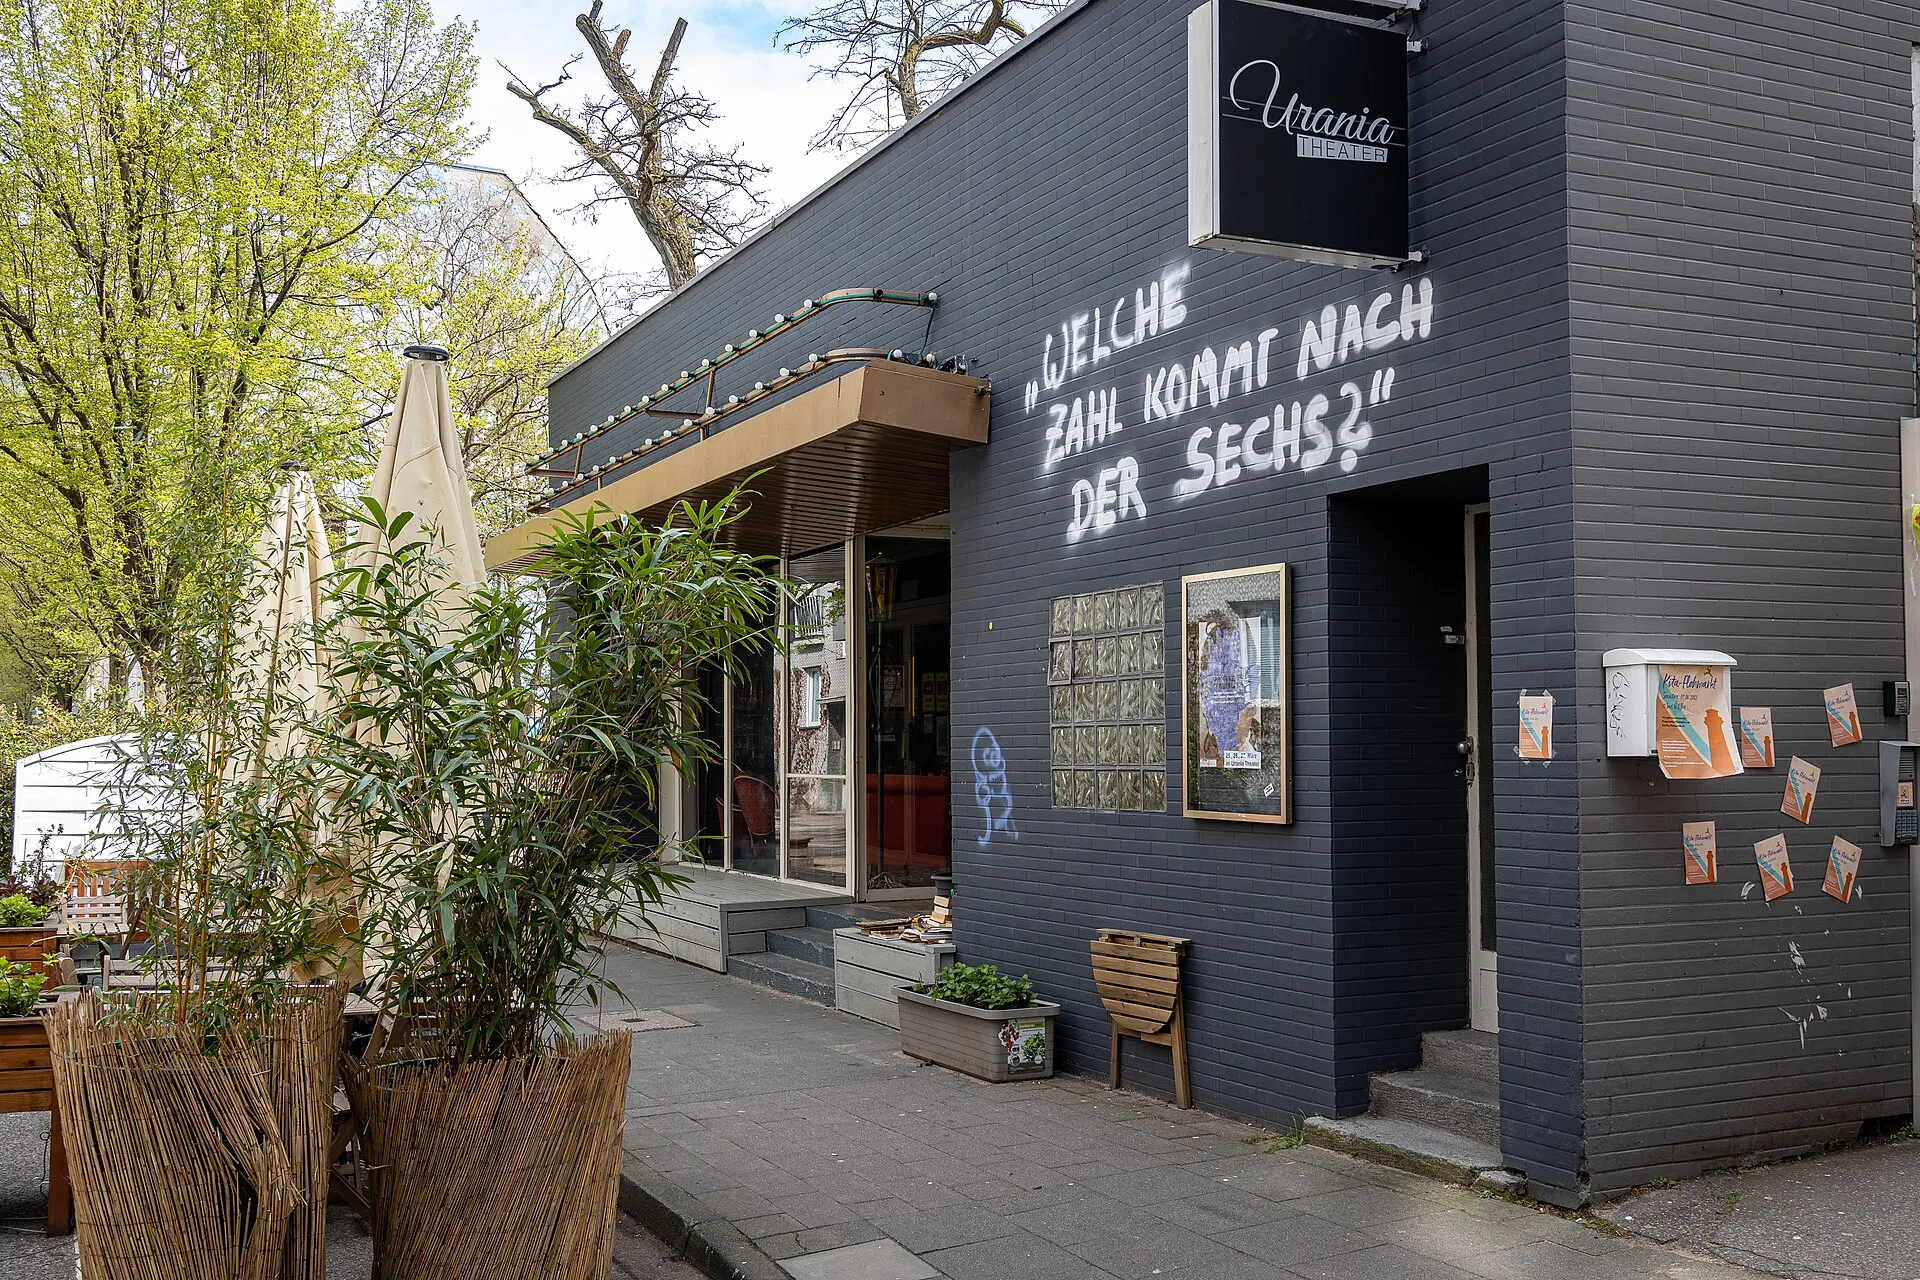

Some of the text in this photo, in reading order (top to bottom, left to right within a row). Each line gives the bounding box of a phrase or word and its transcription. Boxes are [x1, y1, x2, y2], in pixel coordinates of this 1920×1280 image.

[1230, 59, 1395, 144] Urania
[1298, 136, 1387, 162] THEATER
[1044, 277, 1435, 470] ZAHL KOMMT NACH
[1067, 456, 1148, 545] DER
